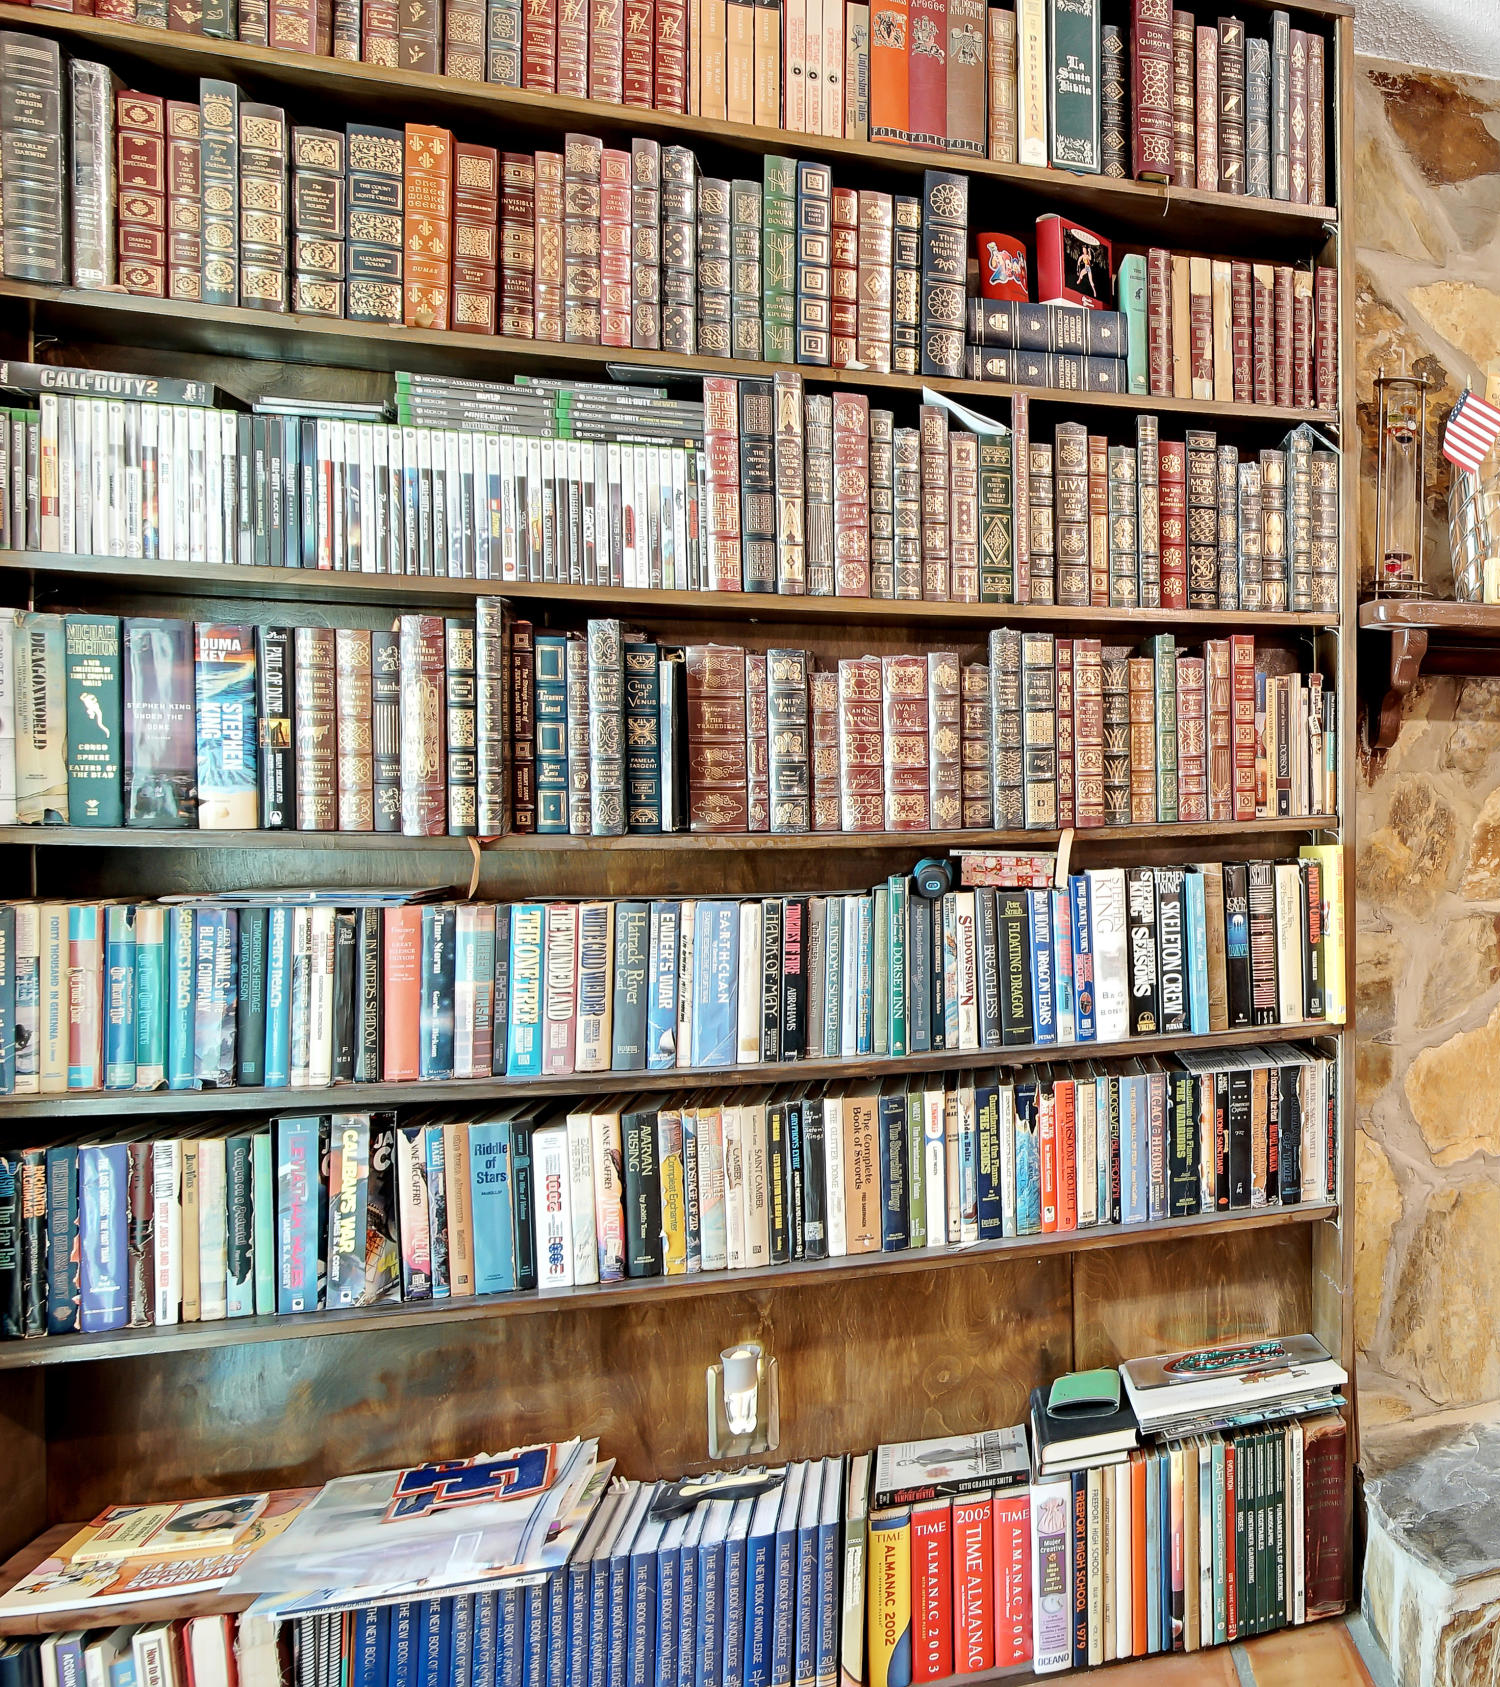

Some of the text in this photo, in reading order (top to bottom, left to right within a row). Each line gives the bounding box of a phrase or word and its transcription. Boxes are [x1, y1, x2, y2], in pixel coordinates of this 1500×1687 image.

[1139, 37, 1171, 50] QUIXOTE
[1146, 31, 1163, 39] DON
[1066, 55, 1085, 71] La
[1057, 67, 1091, 84] Santa
[1058, 79, 1092, 97] Biblia
[15, 98, 43, 109] ORIGIN
[13, 117, 45, 127] SPECIES
[872, 127, 908, 140] FOLIO
[910, 133, 945, 148] FOLIO
[12, 141, 48, 152] CHARLES
[14, 149, 46, 159] DARWIN
[949, 139, 984, 152] FOLIO
[501, 198, 534, 209] INVISIBLE
[929, 240, 963, 252] Arabian
[938, 233, 955, 242] The
[929, 247, 961, 258] Nights
[40, 369, 88, 390] CALL
[94, 375, 146, 397] DUTY
[146, 380, 159, 397] 2
[1058, 479, 1087, 491] LIVY
[200, 638, 242, 651] DUMA
[200, 650, 226, 662] KEY
[266, 646, 282, 713] PAUL OF DUNE
[894, 703, 917, 712] WAR
[201, 702, 221, 739] KING
[222, 703, 244, 770] STEPHEN
[77, 753, 110, 762] SPHERE
[1160, 881, 1180, 893] KING
[515, 910, 541, 945] THE
[550, 908, 576, 935] THE
[548, 933, 575, 988] WOUNDED
[616, 912, 628, 990] Orson Scott Card
[626, 911, 645, 1004] Hatrack River
[658, 913, 675, 1009] ENDER'S WAR
[959, 915, 974, 1006] SHADOWSPAWN
[1161, 902, 1183, 1014] SKELETON CREW
[198, 926, 214, 1012] BLACK COMPANY
[240, 932, 250, 1001] JUANITA COULSON
[513, 945, 540, 980] ONE
[1008, 922, 1024, 1018] FLOATING DRAGON
[893, 948, 903, 1019] DORSET INN
[984, 944, 998, 1018] BREATHLESS
[1038, 951, 1052, 1026] DRAGON TEARS
[512, 979, 540, 1025] TREE
[547, 986, 574, 1021] LAND
[787, 987, 797, 1031] ABRAHAMS
[475, 1143, 508, 1156] Riddle
[628, 1129, 640, 1172] RISING
[639, 1125, 652, 1176] AVARYAN
[686, 1139, 697, 1157] THE
[853, 1106, 862, 1190] Book of Swords
[864, 1110, 873, 1184] The Complete
[485, 1157, 497, 1170] of
[477, 1171, 507, 1183] Stars
[687, 1158, 699, 1200] HOSTAGE
[23, 1165, 33, 1219] PILGRIMAGE
[34, 1166, 45, 1217] ENCHANTED
[956, 1506, 991, 1524] 2005
[1000, 1508, 1030, 1523] TIME
[875, 1532, 904, 1543] TIME
[915, 1521, 946, 1536] TIME
[1040, 1544, 1065, 1554] Creativa
[1043, 1538, 1061, 1549] Mujer
[884, 1545, 896, 1606] ALMANAC
[1076, 1490, 1086, 1649] FREEPORT HIGH SCHOOL 1979
[823, 1536, 833, 1650] THE NEW BOOK OF KNOWLEDGE
[965, 1524, 984, 1668] TIME ALMANAC
[1012, 1528, 1024, 1658] ALMANAC 2004
[753, 1547, 765, 1665] THE NEW BOOK OF KNOWLEDGE
[927, 1541, 940, 1673] ALMANAC 2003
[885, 1611, 896, 1646] 2002
[776, 1665, 787, 1673] 18
[799, 1660, 809, 1668] 19
[822, 1656, 833, 1665] 20
[1037, 1652, 1070, 1666] OCEANO
[752, 1670, 763, 1679] 17
